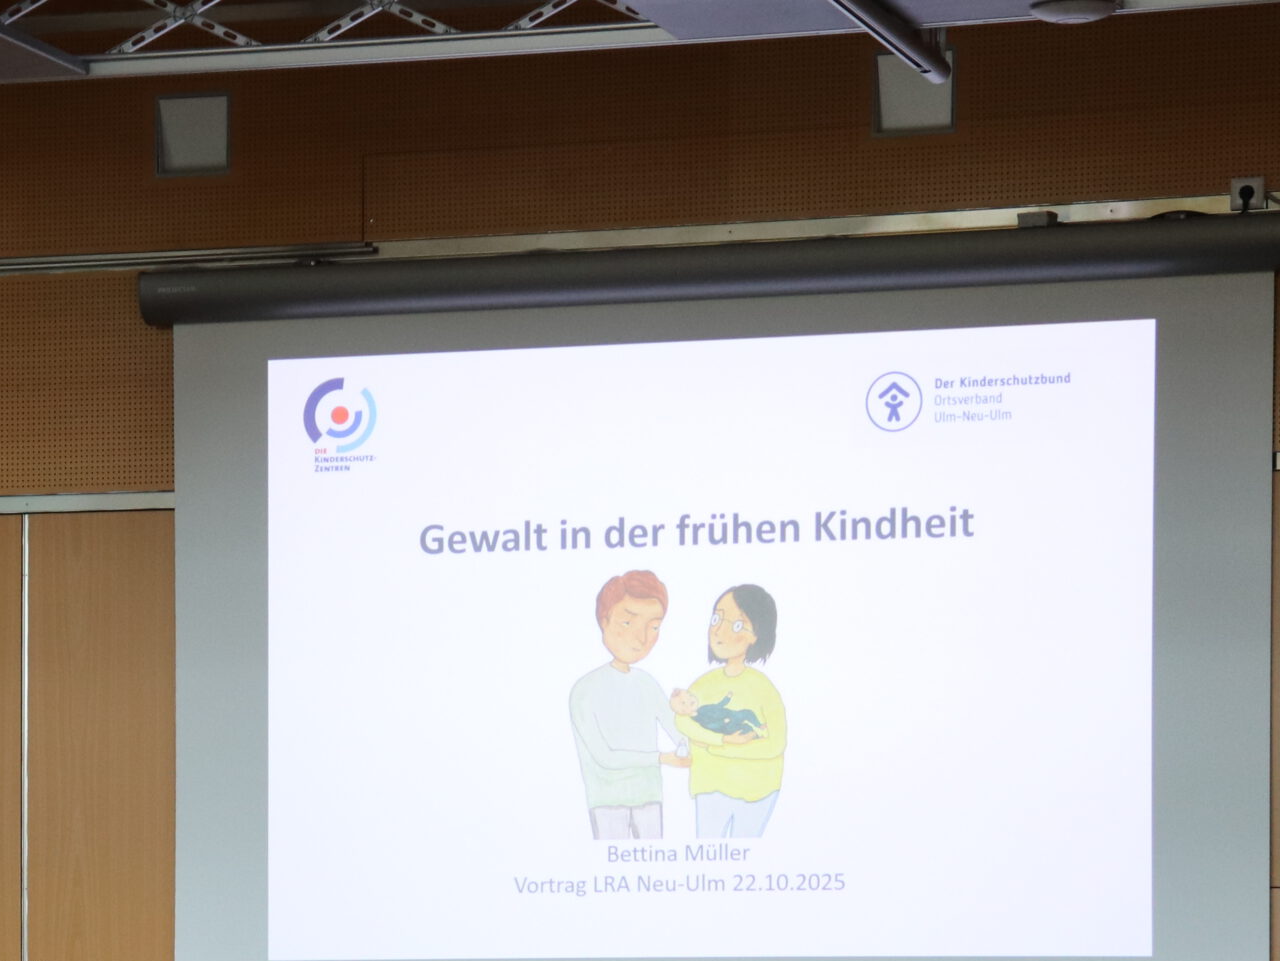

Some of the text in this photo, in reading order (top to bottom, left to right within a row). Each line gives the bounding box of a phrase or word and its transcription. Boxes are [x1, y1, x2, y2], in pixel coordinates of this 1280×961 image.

[934, 372, 1072, 389] Der Kinderschutzbund
[933, 392, 1003, 406] Ortsverband
[933, 409, 1013, 424] Ulm-Neu-Ulm
[419, 506, 975, 556] Gewalt in der frühen Kindheit
[606, 843, 751, 863] Bettina Müller
[513, 873, 846, 897] Vortrag LRA Neu-Ulm 22.10.2025
